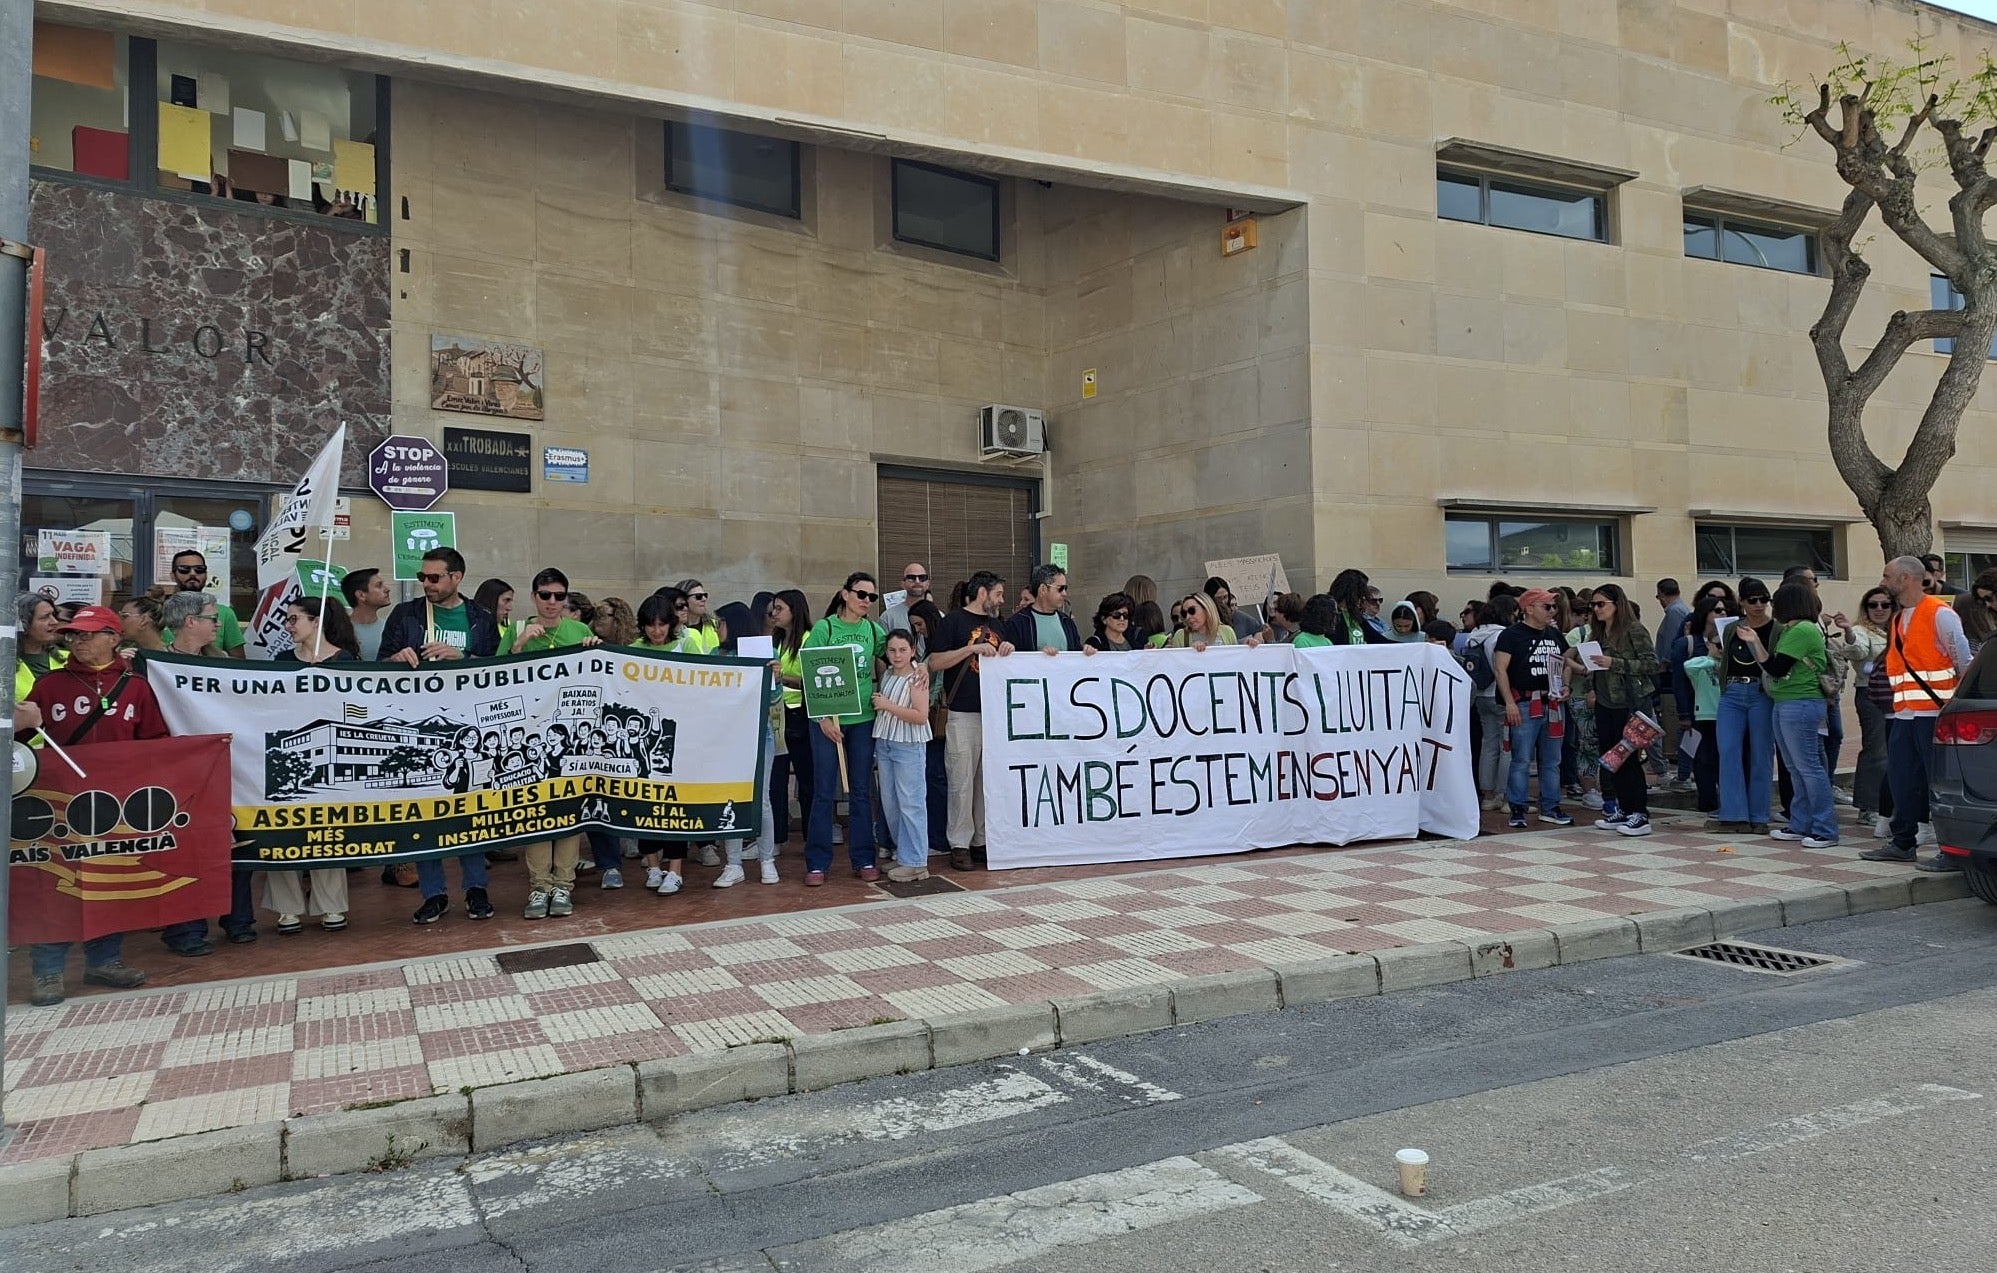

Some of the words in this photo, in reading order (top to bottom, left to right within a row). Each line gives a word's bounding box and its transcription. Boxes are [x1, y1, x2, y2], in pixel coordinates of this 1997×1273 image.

[41, 307, 273, 366] VALOR
[384, 446, 434, 461] STOP
[462, 436, 514, 456] TROBADA
[548, 452, 585, 463] Erasmus+
[375, 460, 388, 475] A
[392, 463, 402, 472] la
[481, 465, 529, 476] VALENCIANES
[388, 475, 399, 484] de
[42, 531, 53, 540] 11
[52, 540, 97, 553] VAGA
[55, 552, 96, 561] INDEFINIDA
[175, 675, 222, 694] PER
[232, 678, 286, 695] UNA
[296, 673, 445, 695] EDUCACIÓ
[455, 661, 570, 691] PÚBLICA
[577, 661, 583, 675] I
[591, 659, 614, 675] DE
[622, 661, 744, 688] QUALITAT!
[562, 689, 597, 699] BAIXADA
[489, 701, 509, 713] MÉS
[571, 708, 585, 716] JA!
[1006, 677, 1108, 742] ELS
[1111, 671, 1310, 740] DOCENTS
[480, 709, 523, 723] PROFESSORAT
[339, 730, 352, 738] IES
[353, 731, 364, 739] LA
[365, 733, 397, 742] CREUETA
[569, 760, 579, 772] SÍ
[580, 763, 588, 771] AL
[1009, 744, 1142, 828] TAMBÉ
[1151, 751, 1273, 816] ESTEM
[253, 801, 423, 828] ASSEMBLEA
[433, 798, 466, 818] DE
[551, 780, 576, 800] LA
[582, 775, 678, 802] CREUETA
[472, 805, 547, 828] MILLORS
[652, 805, 667, 817] SÍ
[669, 806, 686, 818] AL
[635, 815, 704, 830] VALENCIÀ
[307, 828, 345, 843] MÉS
[438, 814, 576, 847] INSTAL·LACIONS
[9, 843, 51, 864] AÍS
[59, 832, 177, 861] VALENCIÀ
[259, 841, 396, 860] PROFESSORAT
